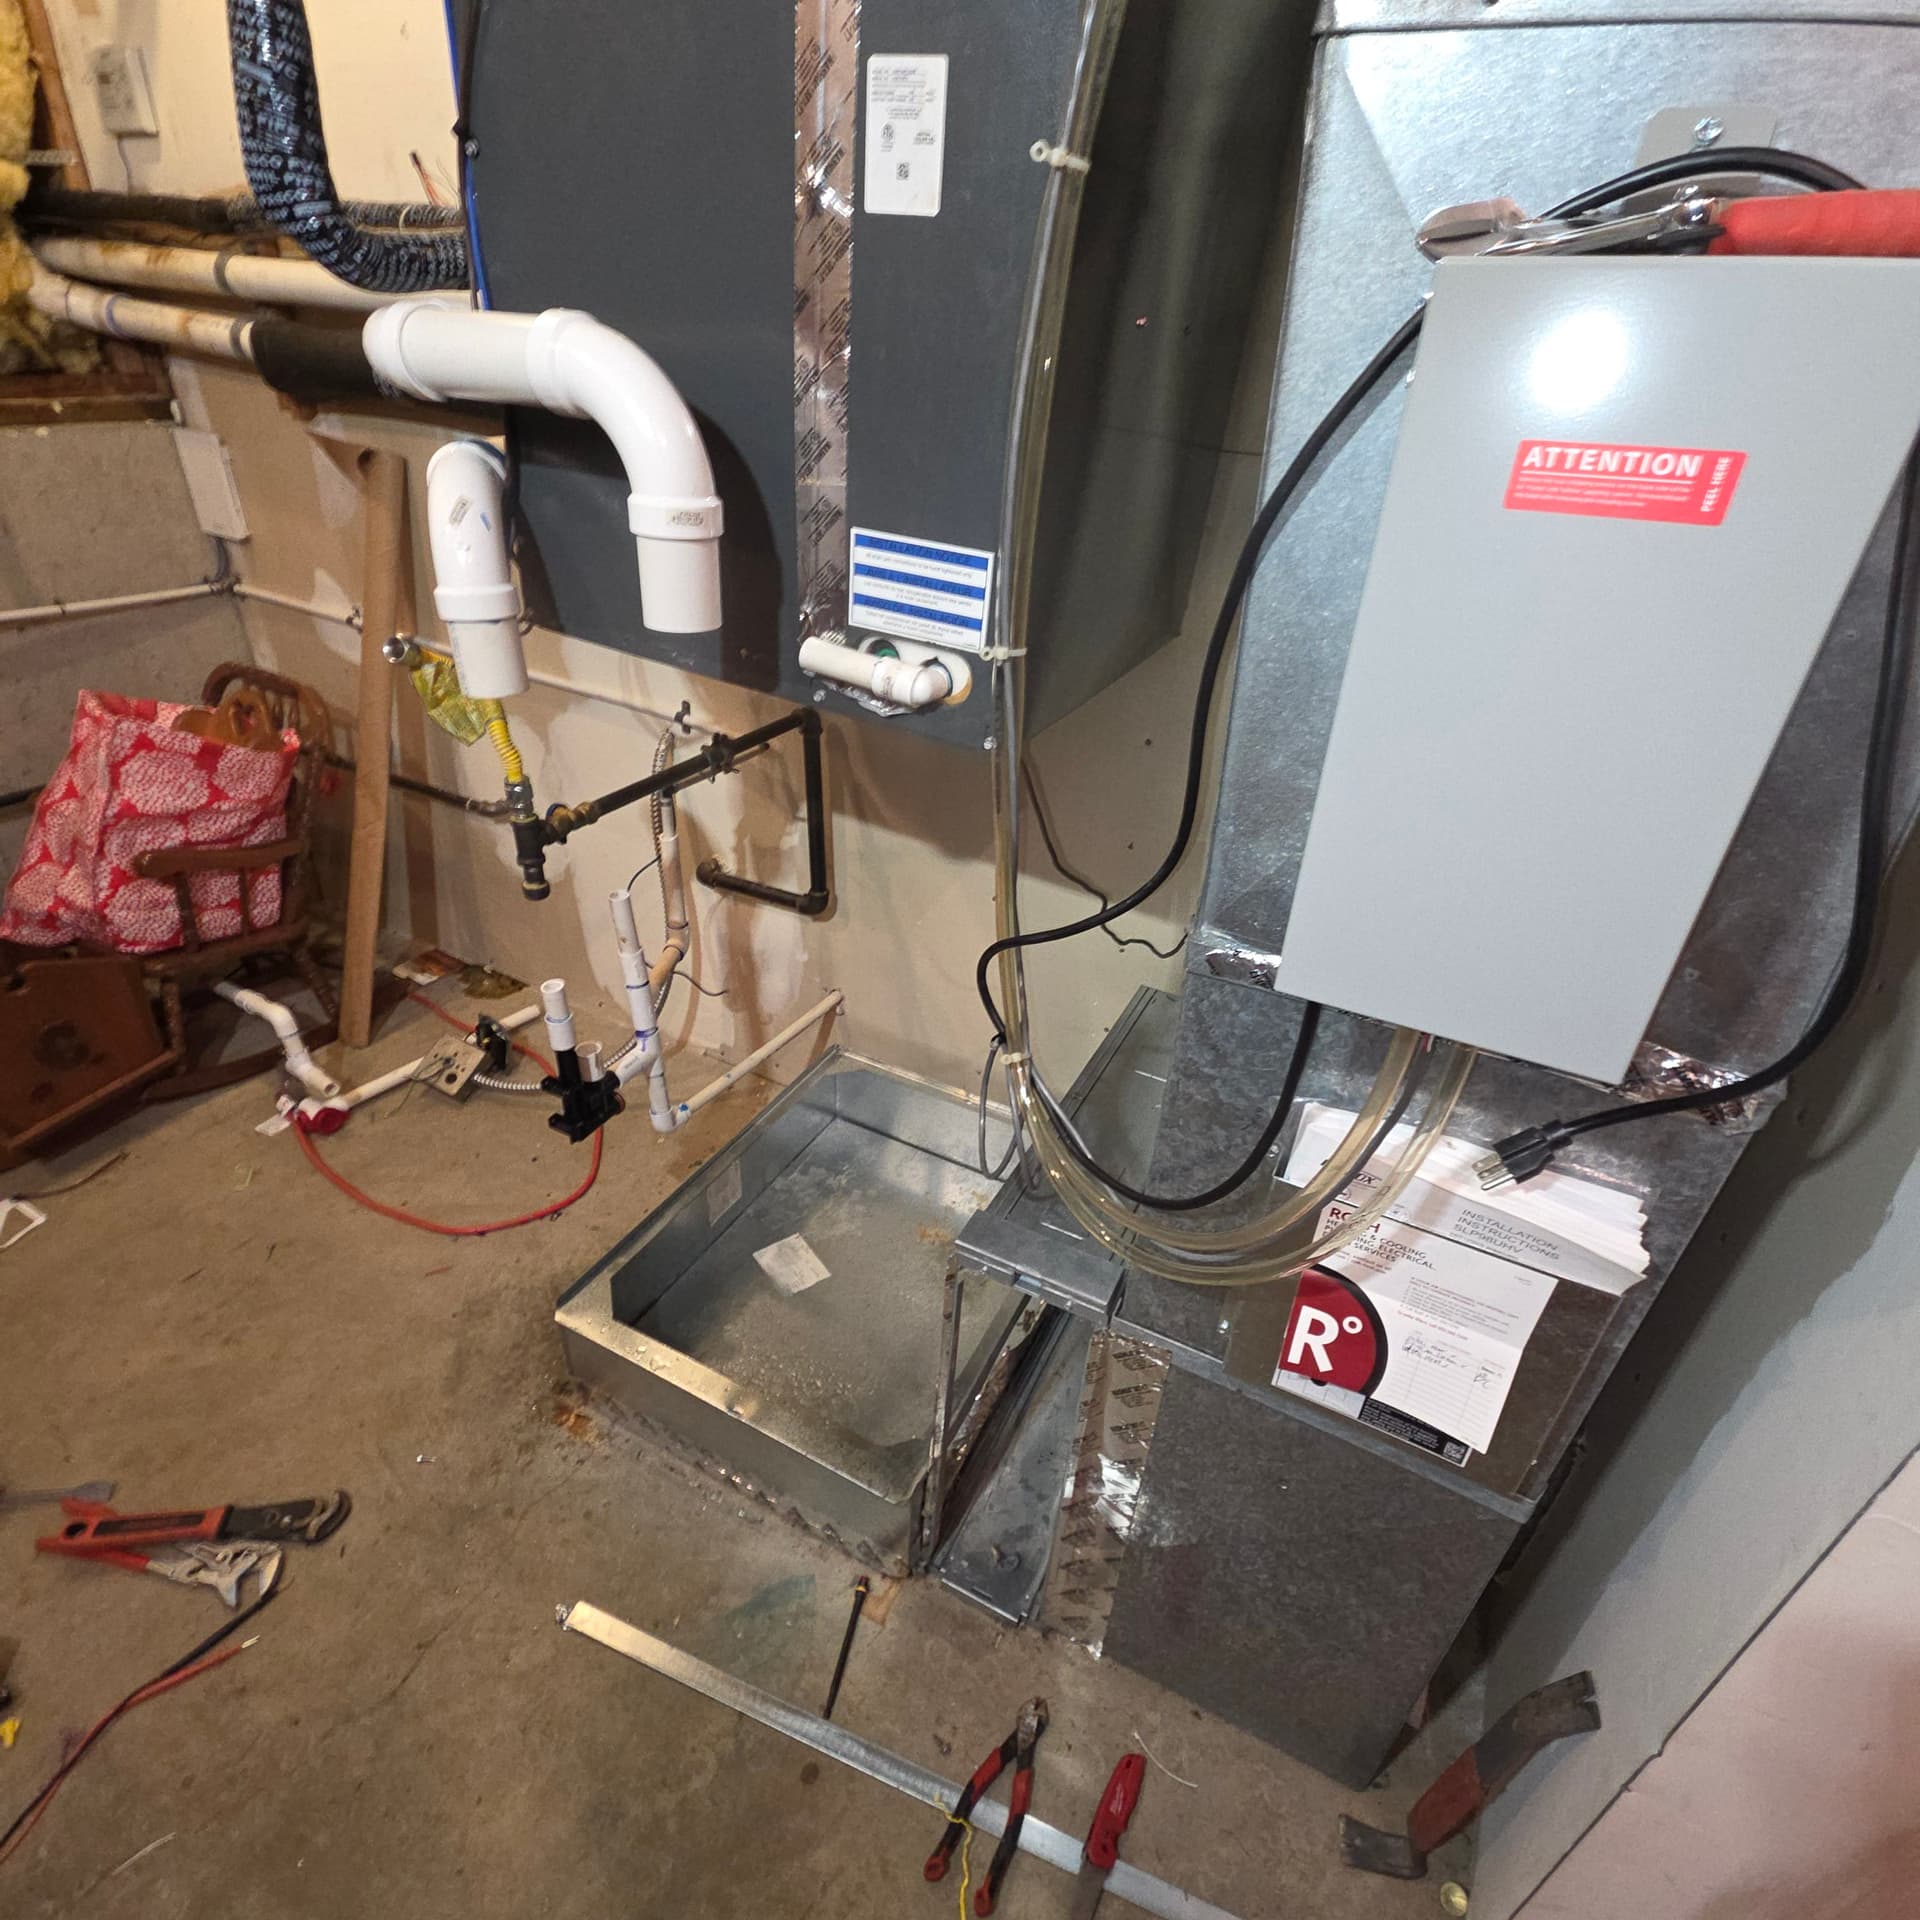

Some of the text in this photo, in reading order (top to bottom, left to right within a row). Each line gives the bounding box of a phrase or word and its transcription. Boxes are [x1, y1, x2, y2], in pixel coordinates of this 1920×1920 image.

[1523, 446, 1703, 477] ATTENTION
[1701, 456, 1733, 512] PEEL HERE
[1457, 1217, 1560, 1260] INSTRUCTIONS
[1462, 1209, 1558, 1250] INSTALLATION
[1354, 1242, 1396, 1263] SERVICES
